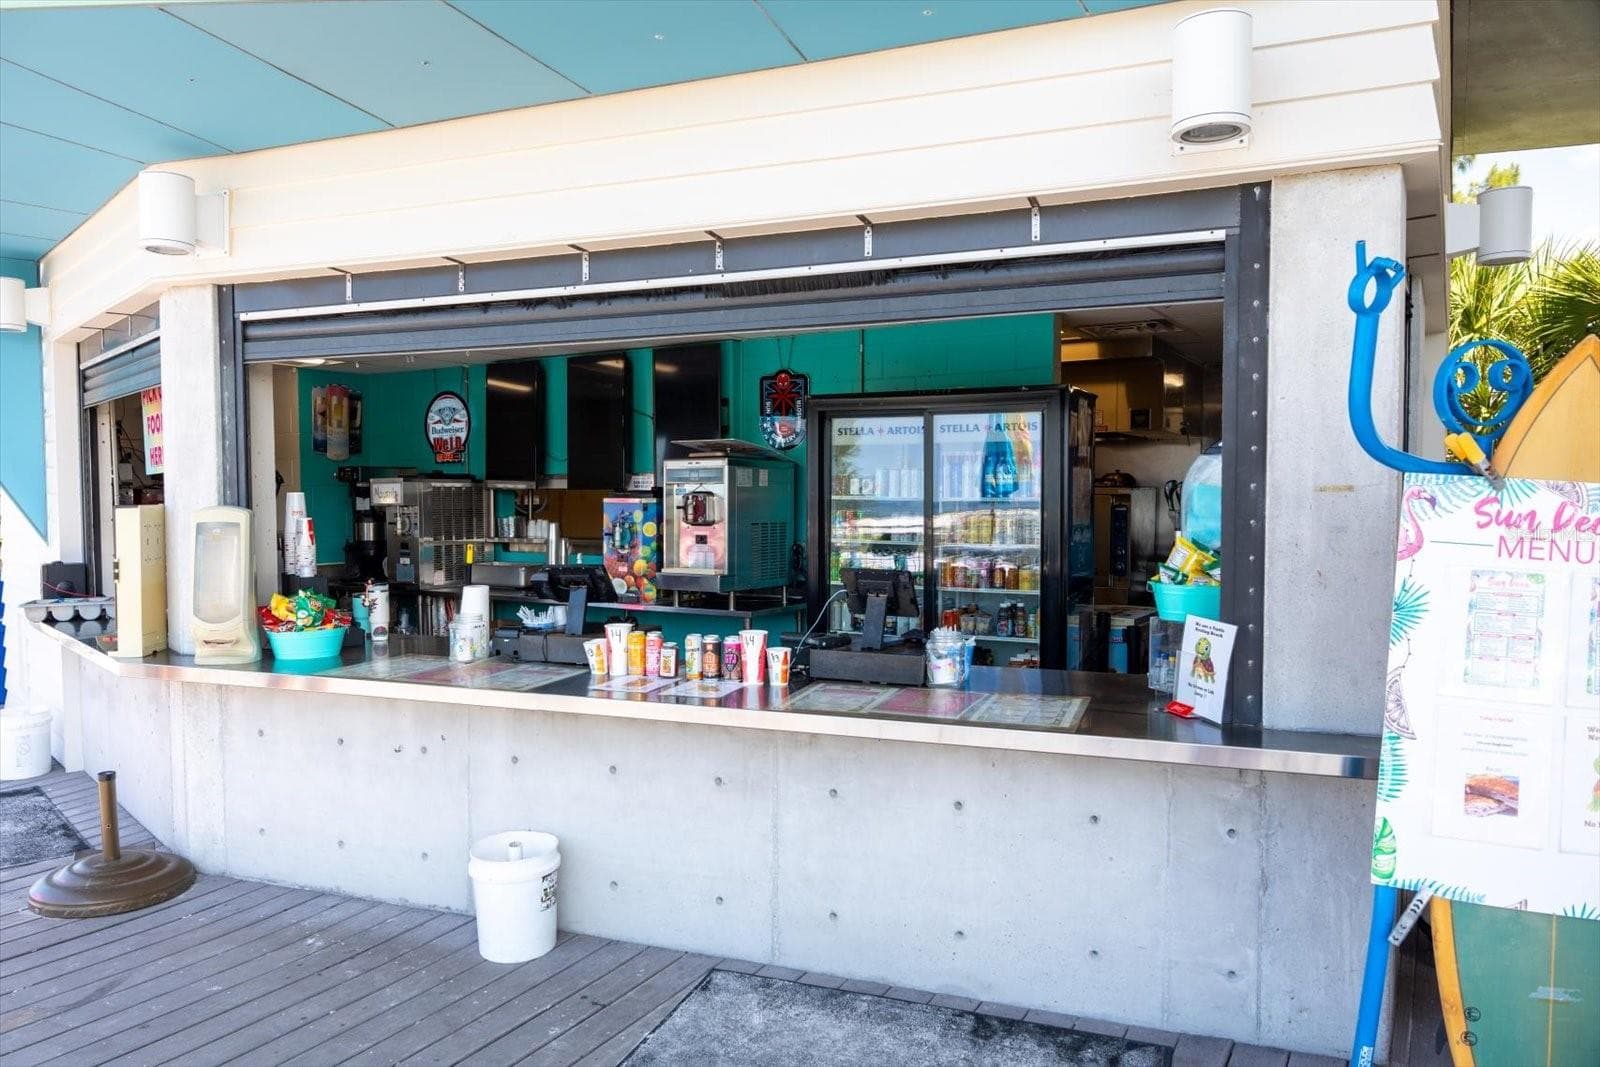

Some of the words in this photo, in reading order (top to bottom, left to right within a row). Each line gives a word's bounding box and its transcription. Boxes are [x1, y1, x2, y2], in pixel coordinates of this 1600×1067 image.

[147, 414, 162, 434] FOO
[431, 425, 465, 435] Budweiser
[837, 425, 874, 436] STELLA
[939, 423, 980, 433] STELLA
[994, 421, 1038, 432] ARTOIS
[150, 446, 164, 466] HER
[1473, 495, 1541, 532] Sun
